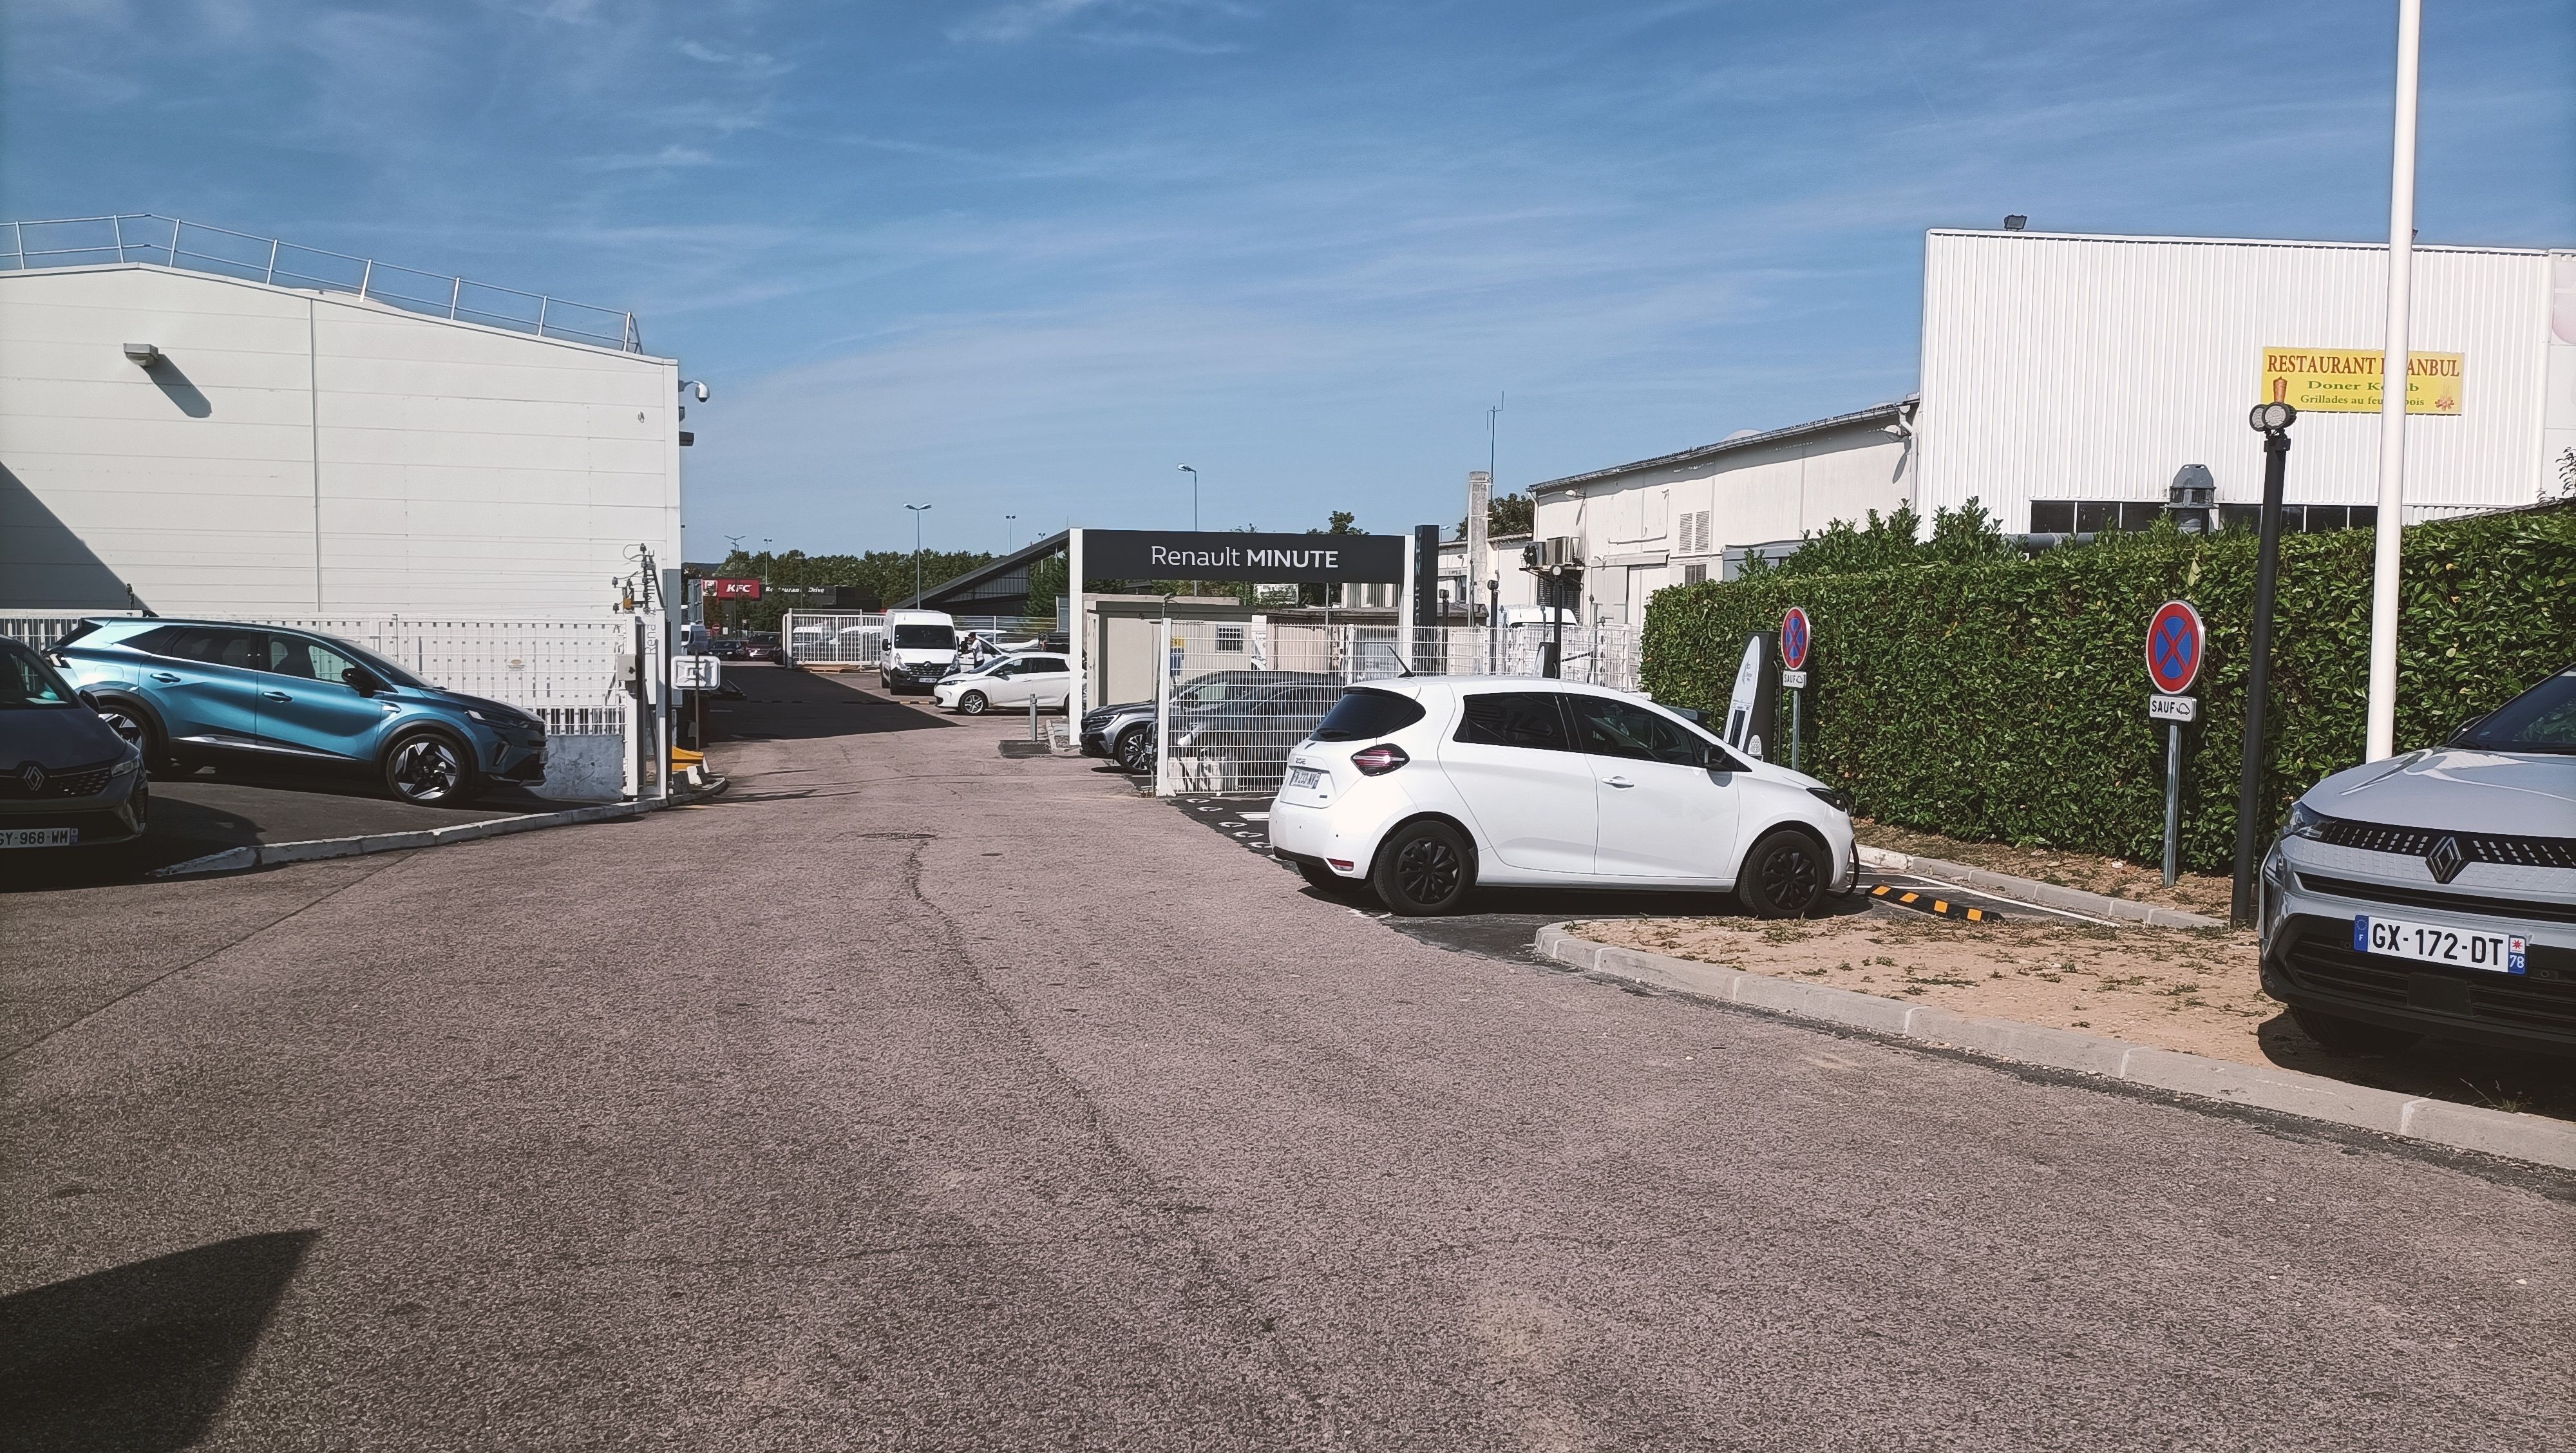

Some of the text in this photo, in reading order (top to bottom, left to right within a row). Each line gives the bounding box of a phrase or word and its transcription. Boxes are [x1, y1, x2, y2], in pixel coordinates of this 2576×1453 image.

[2267, 355, 2459, 377] RESTAURANT IANBUL
[2308, 381, 2361, 390] Doner
[2300, 394, 2348, 404] Grillades
[1151, 546, 1338, 568] Renault MINUTE
[726, 584, 752, 593] KFC
[1784, 674, 1795, 683] SAUF
[2152, 700, 2175, 714] SAUF
[2372, 923, 2503, 965] GX-172-DT
[2510, 954, 2524, 969] 78
